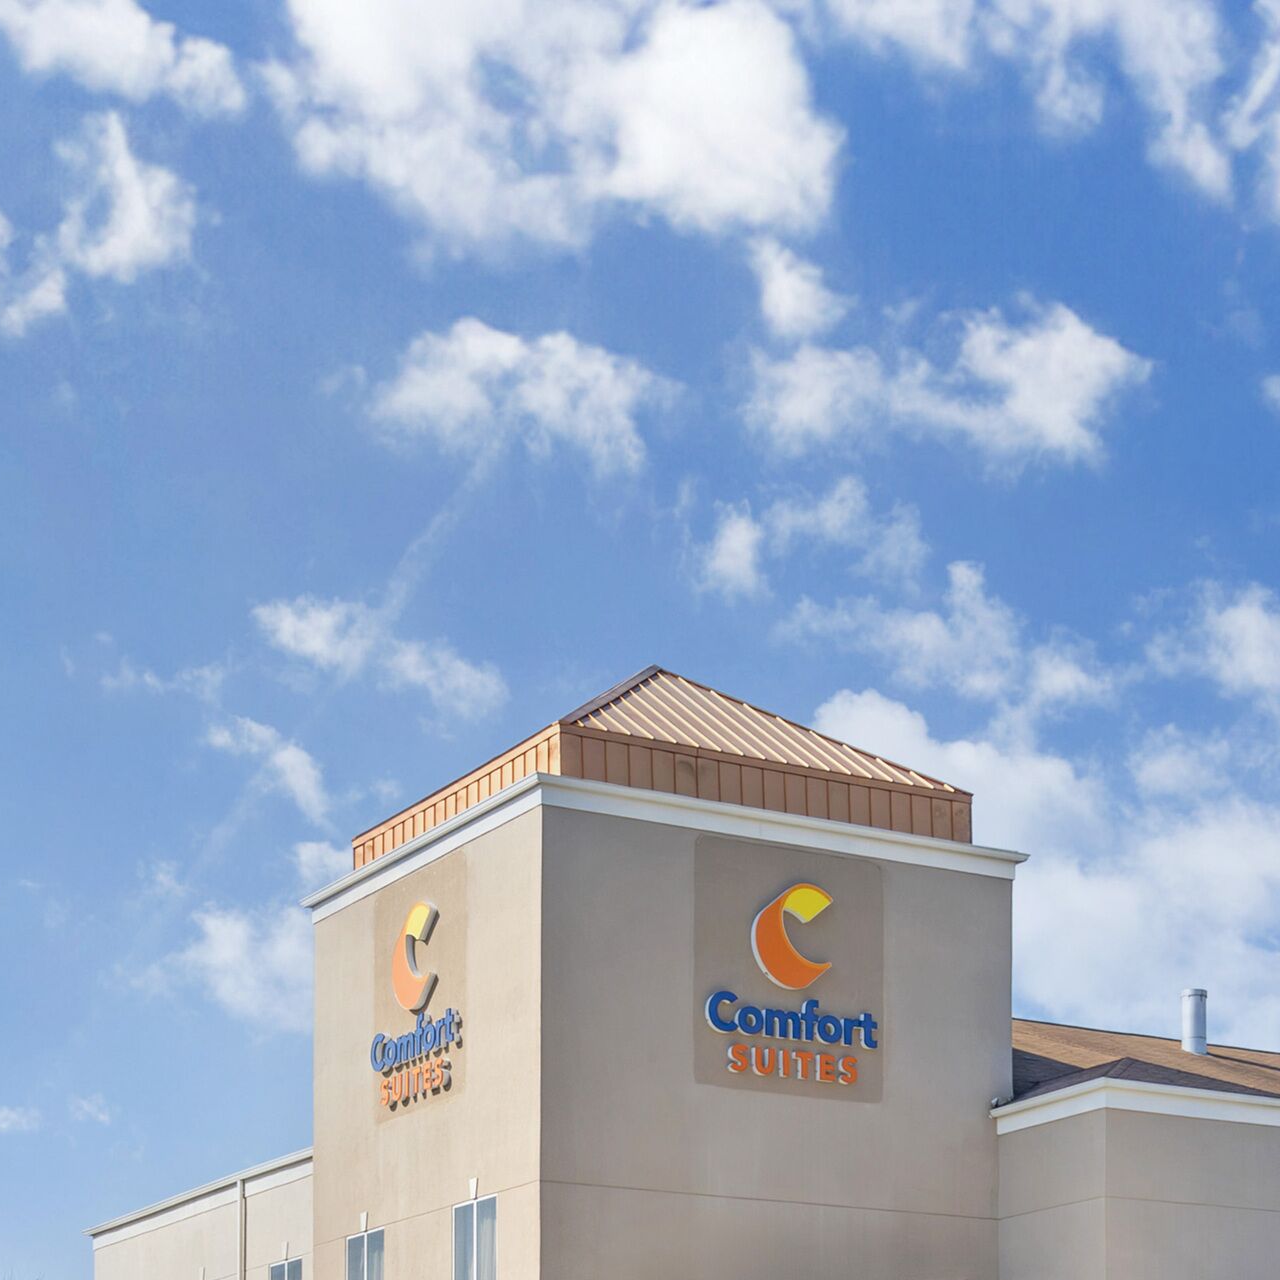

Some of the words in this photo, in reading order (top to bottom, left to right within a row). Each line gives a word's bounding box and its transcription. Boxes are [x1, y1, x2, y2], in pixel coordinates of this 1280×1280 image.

[370, 1007, 458, 1073] Comfort
[702, 990, 878, 1050] Comfort
[379, 1057, 447, 1108] SUITES
[727, 1043, 859, 1085] SUITES
